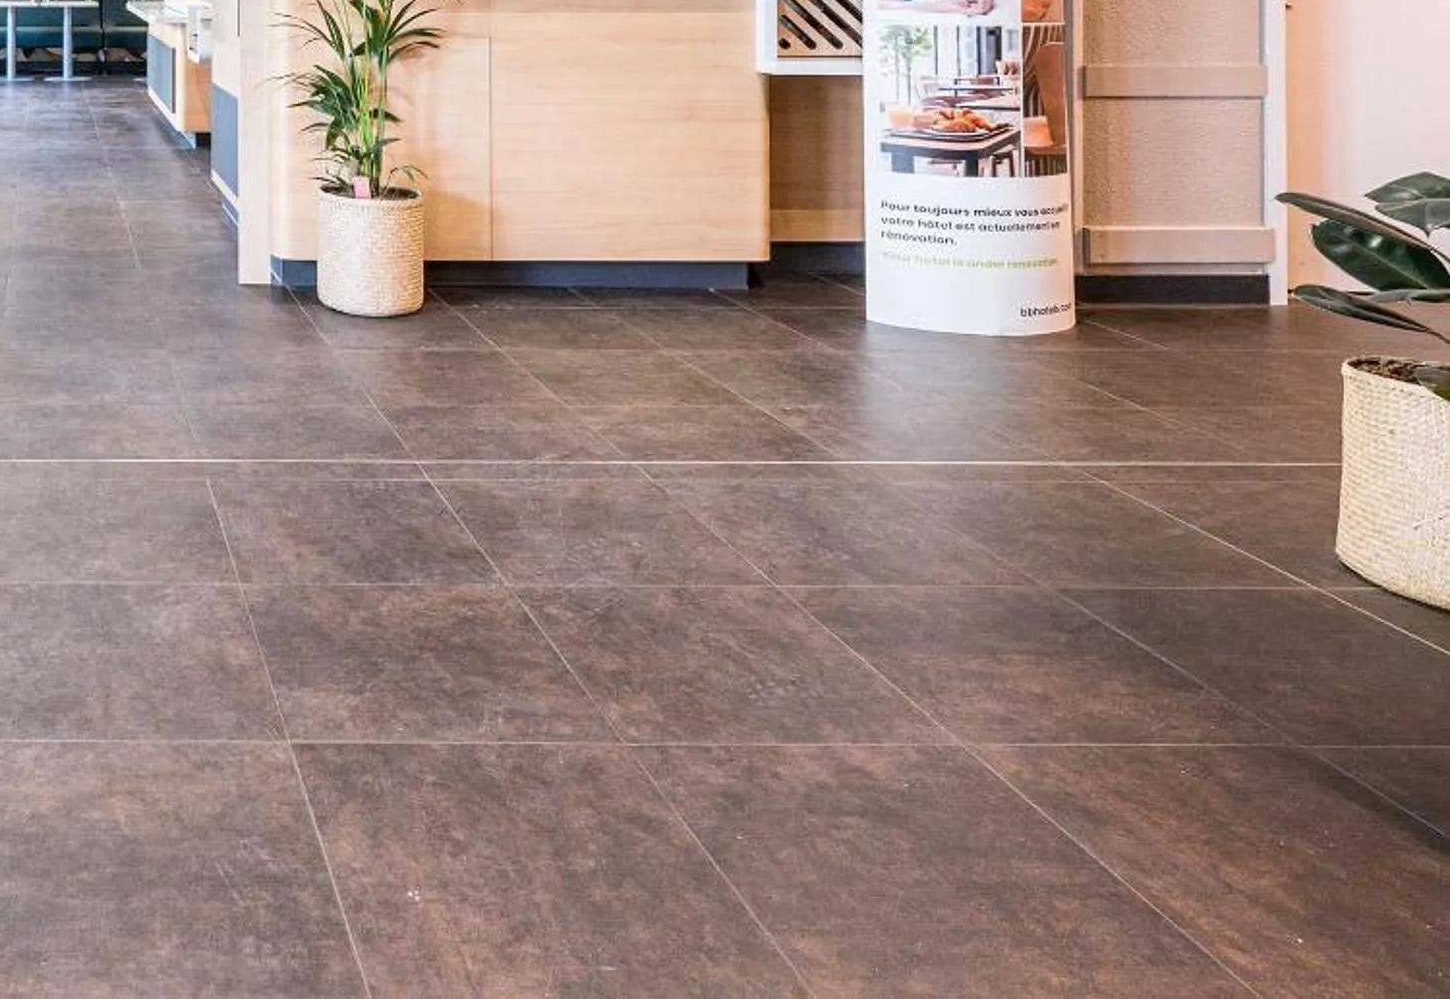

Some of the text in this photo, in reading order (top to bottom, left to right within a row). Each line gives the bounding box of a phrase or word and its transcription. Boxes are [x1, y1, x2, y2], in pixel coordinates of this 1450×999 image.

[881, 200, 910, 211] Pour
[914, 204, 970, 216] toujours
[974, 206, 1012, 217] mieux
[1015, 208, 1039, 217] vous
[881, 217, 914, 226] votre
[954, 222, 975, 230] est
